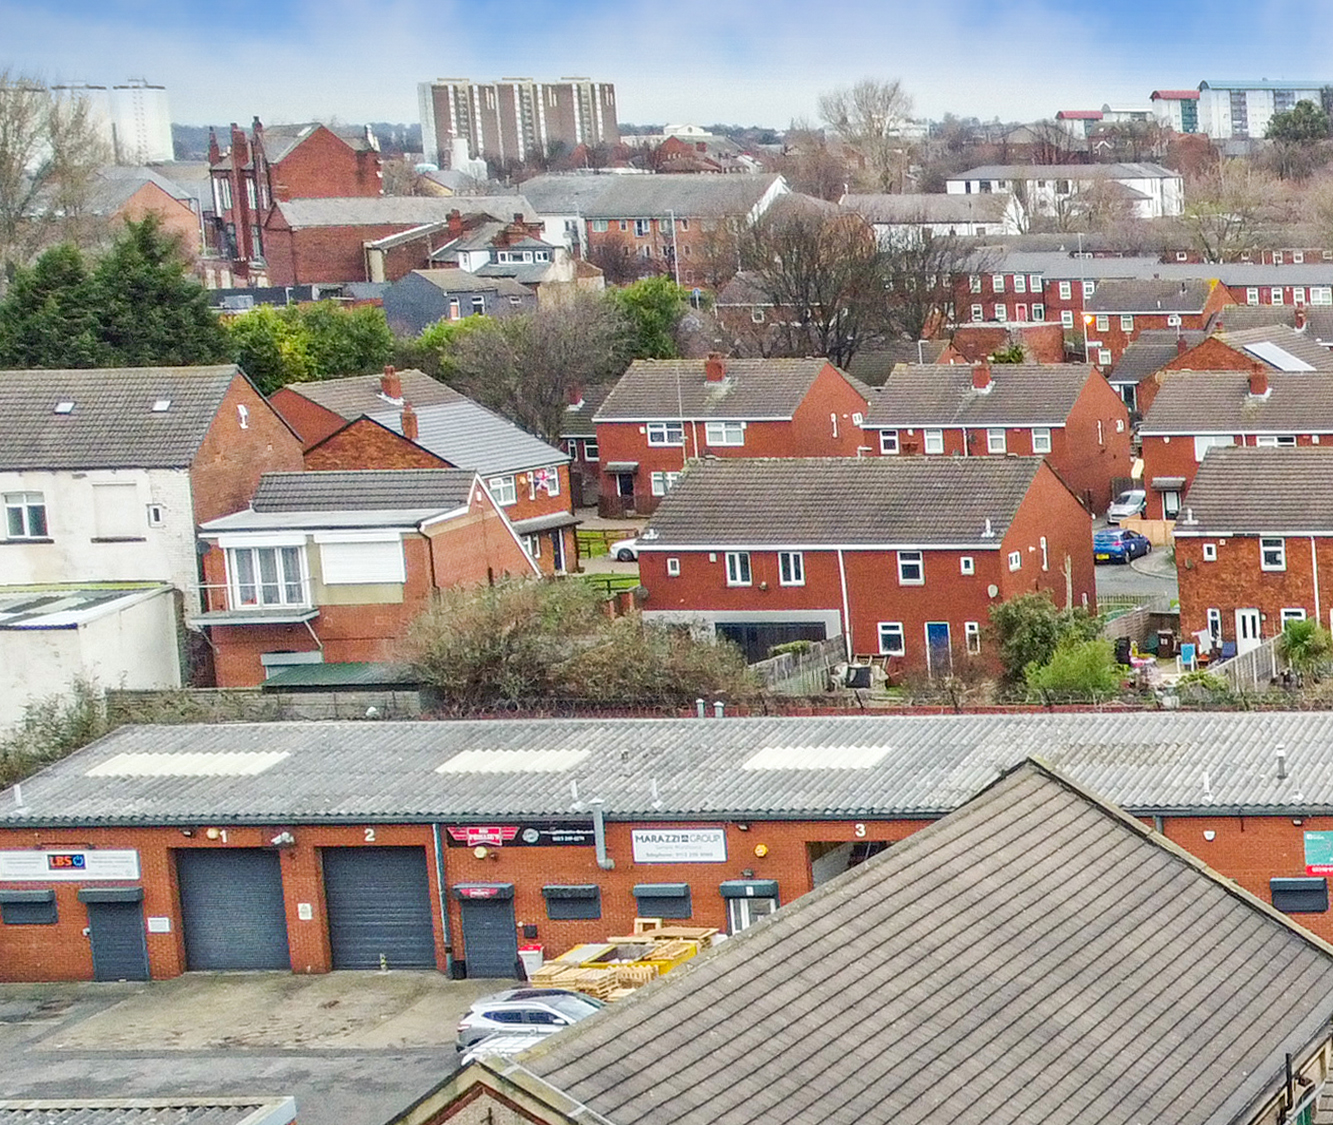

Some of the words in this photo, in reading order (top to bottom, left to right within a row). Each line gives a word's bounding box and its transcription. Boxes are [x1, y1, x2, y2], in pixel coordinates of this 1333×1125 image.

[220, 830, 228, 843] 1
[364, 828, 376, 842] 2
[855, 823, 866, 837] 3
[635, 834, 681, 843] MARAZZI
[689, 834, 721, 843] GROUP
[49, 856, 73, 866] LBS
